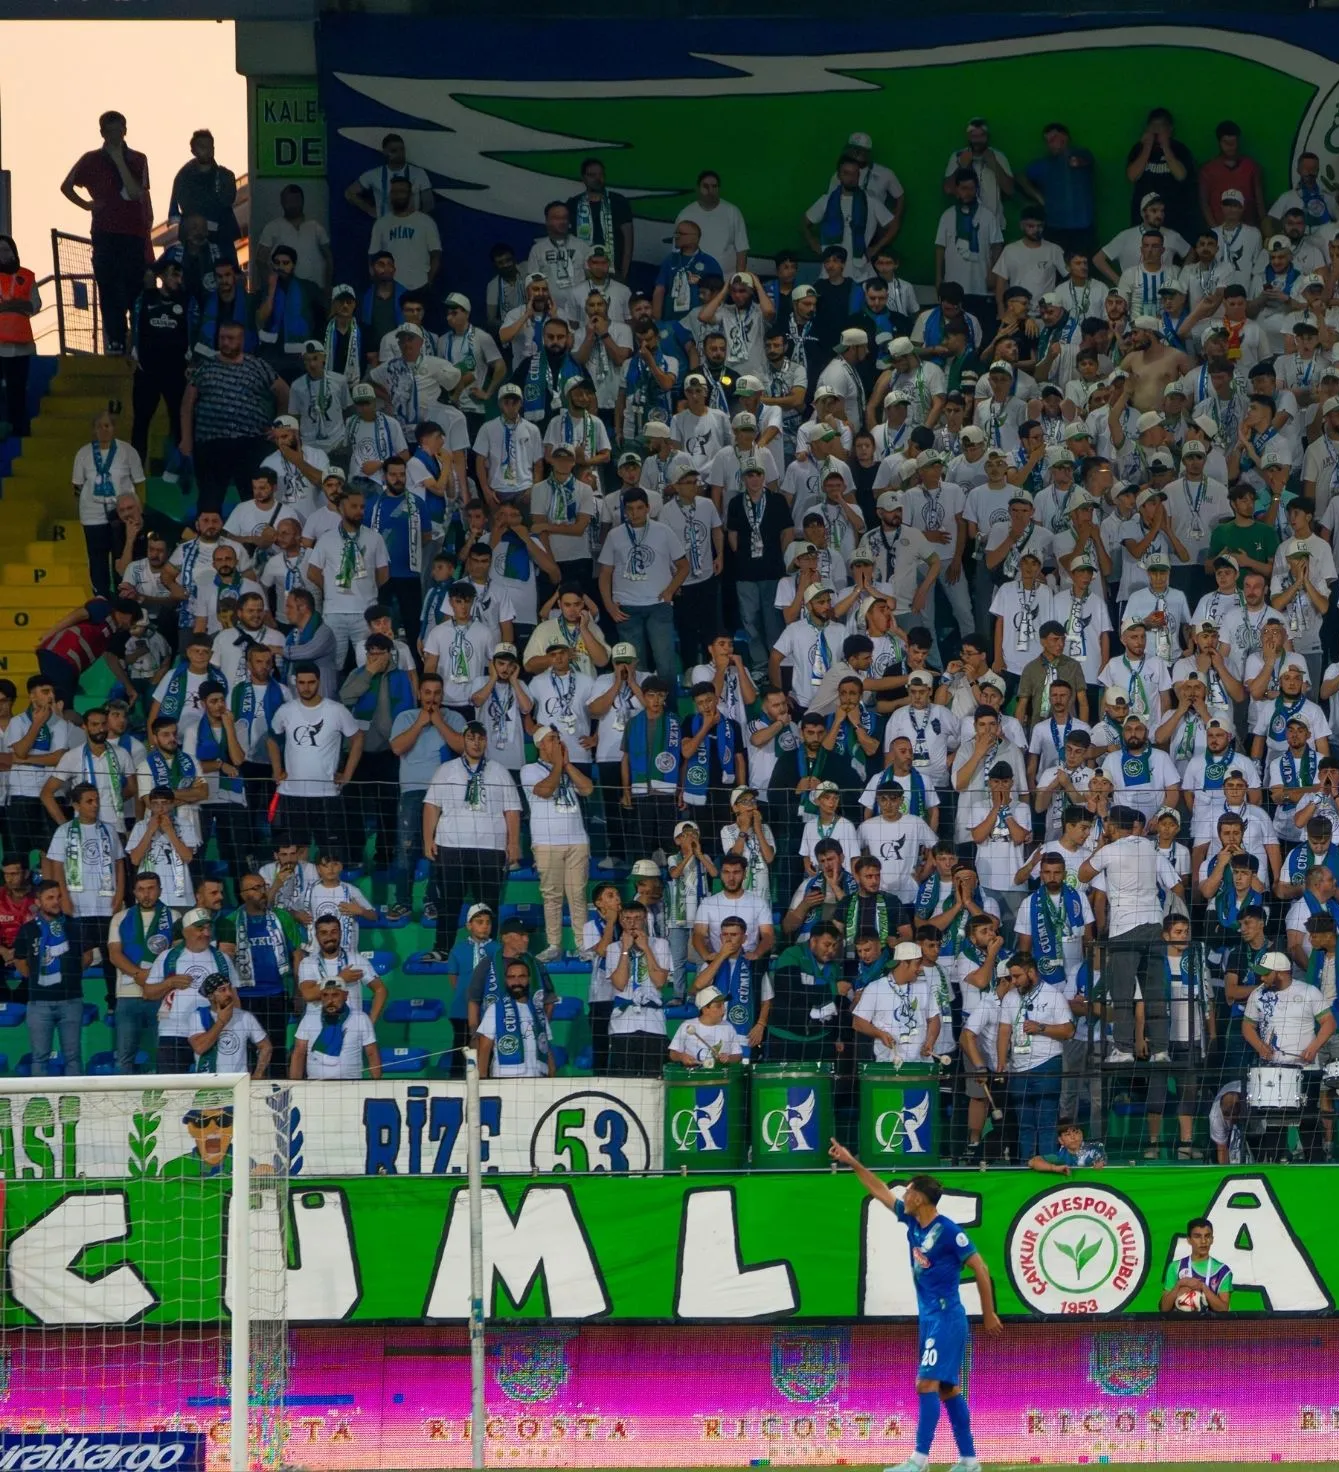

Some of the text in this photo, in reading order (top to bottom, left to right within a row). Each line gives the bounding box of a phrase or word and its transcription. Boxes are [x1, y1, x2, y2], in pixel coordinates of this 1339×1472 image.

[54, 526, 66, 541] R
[34, 569, 47, 583] P
[14, 612, 29, 627] O
[1019, 1196, 1139, 1296] ÇAYKUR RİZESPOR KULÜBÜ
[8, 1186, 986, 1325] CÜMLE
[1061, 1299, 1099, 1314] 1953
